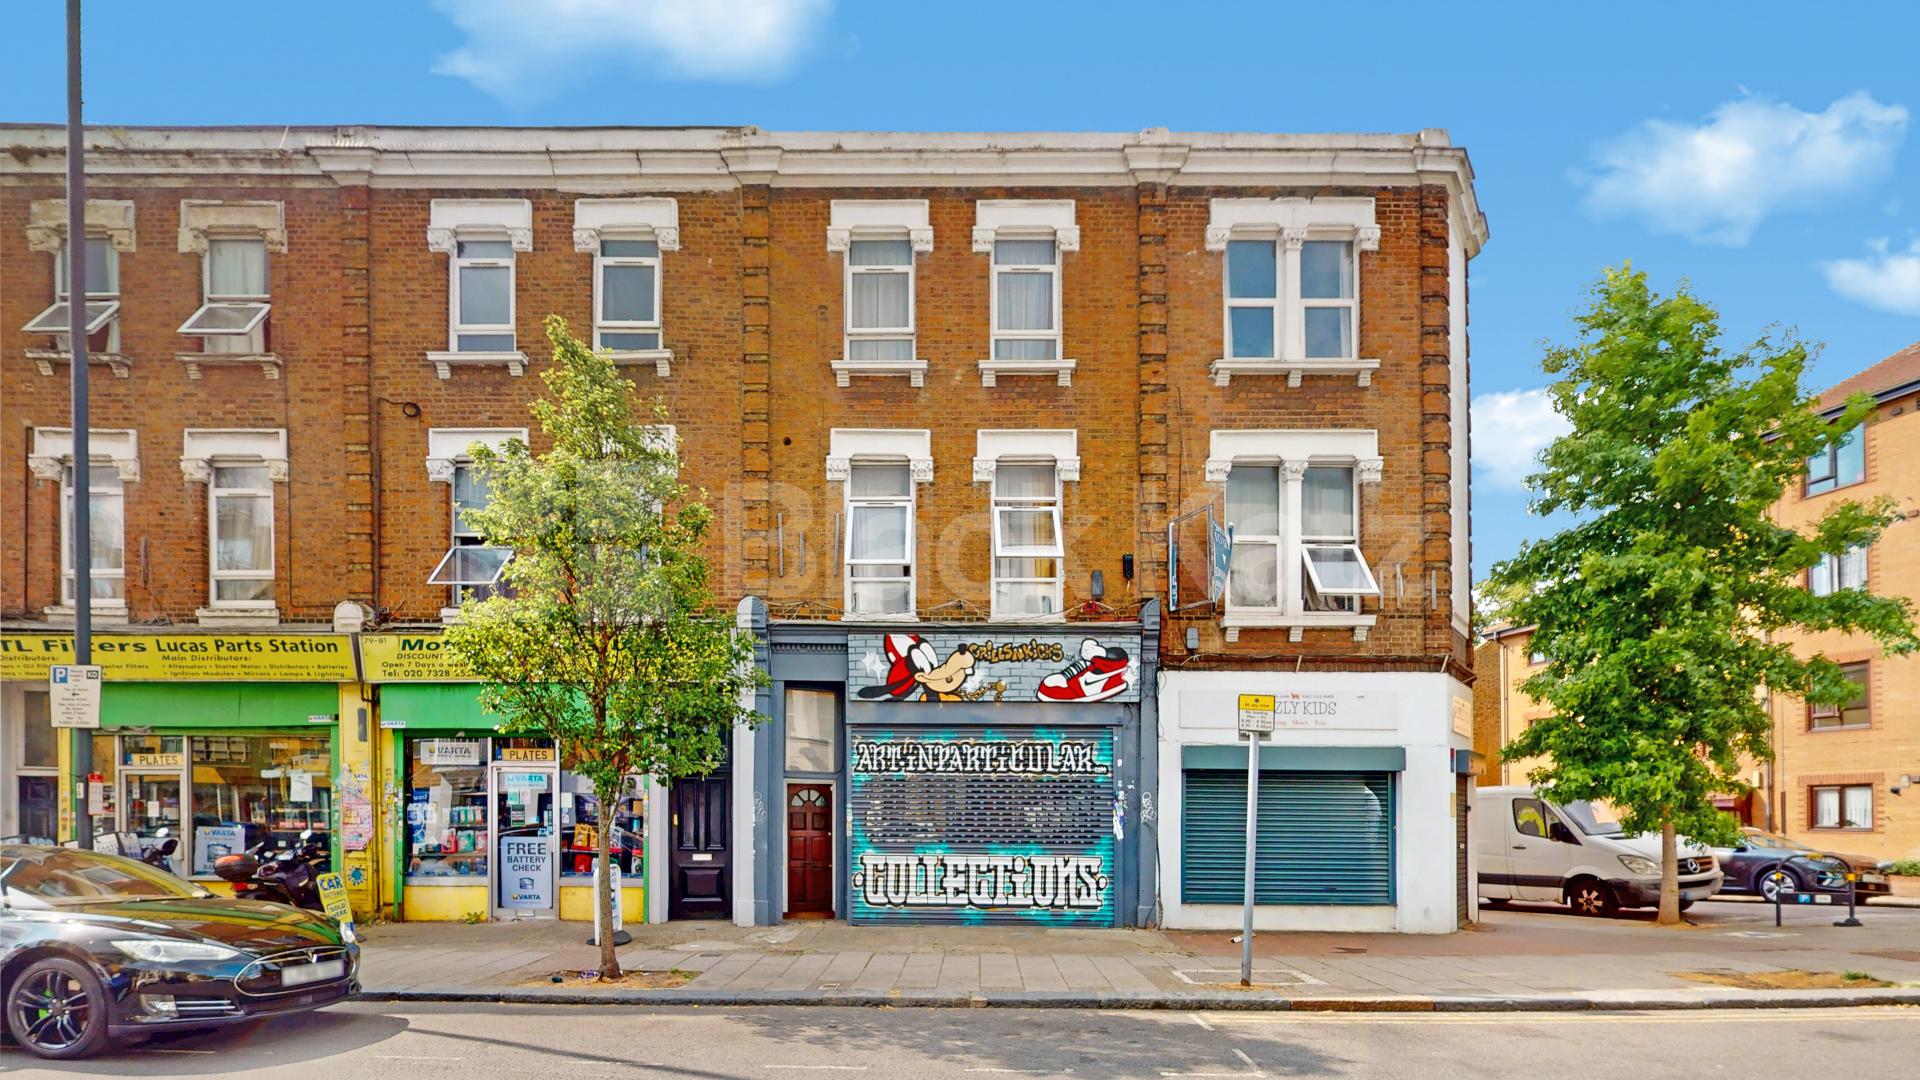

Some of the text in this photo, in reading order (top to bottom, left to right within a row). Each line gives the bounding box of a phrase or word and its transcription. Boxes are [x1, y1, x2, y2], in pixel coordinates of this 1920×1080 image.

[155, 638, 338, 653] Lucas Parts Station
[162, 654, 187, 662] Main
[381, 661, 404, 669] Open
[415, 661, 436, 669] Days
[55, 667, 66, 683] P
[382, 669, 400, 677] Tel:
[404, 669, 423, 677] 020
[426, 669, 450, 677] 7328
[1275, 701, 1337, 715] ZLY KIDS
[437, 746, 471, 755] VARTA
[509, 750, 548, 760] PLATES
[139, 755, 178, 765] PLATES
[211, 829, 236, 837] VARTA
[507, 842, 547, 855] FREE
[507, 855, 546, 864] BATTERY
[512, 864, 542, 872] CHECK
[319, 876, 344, 891] CAR
